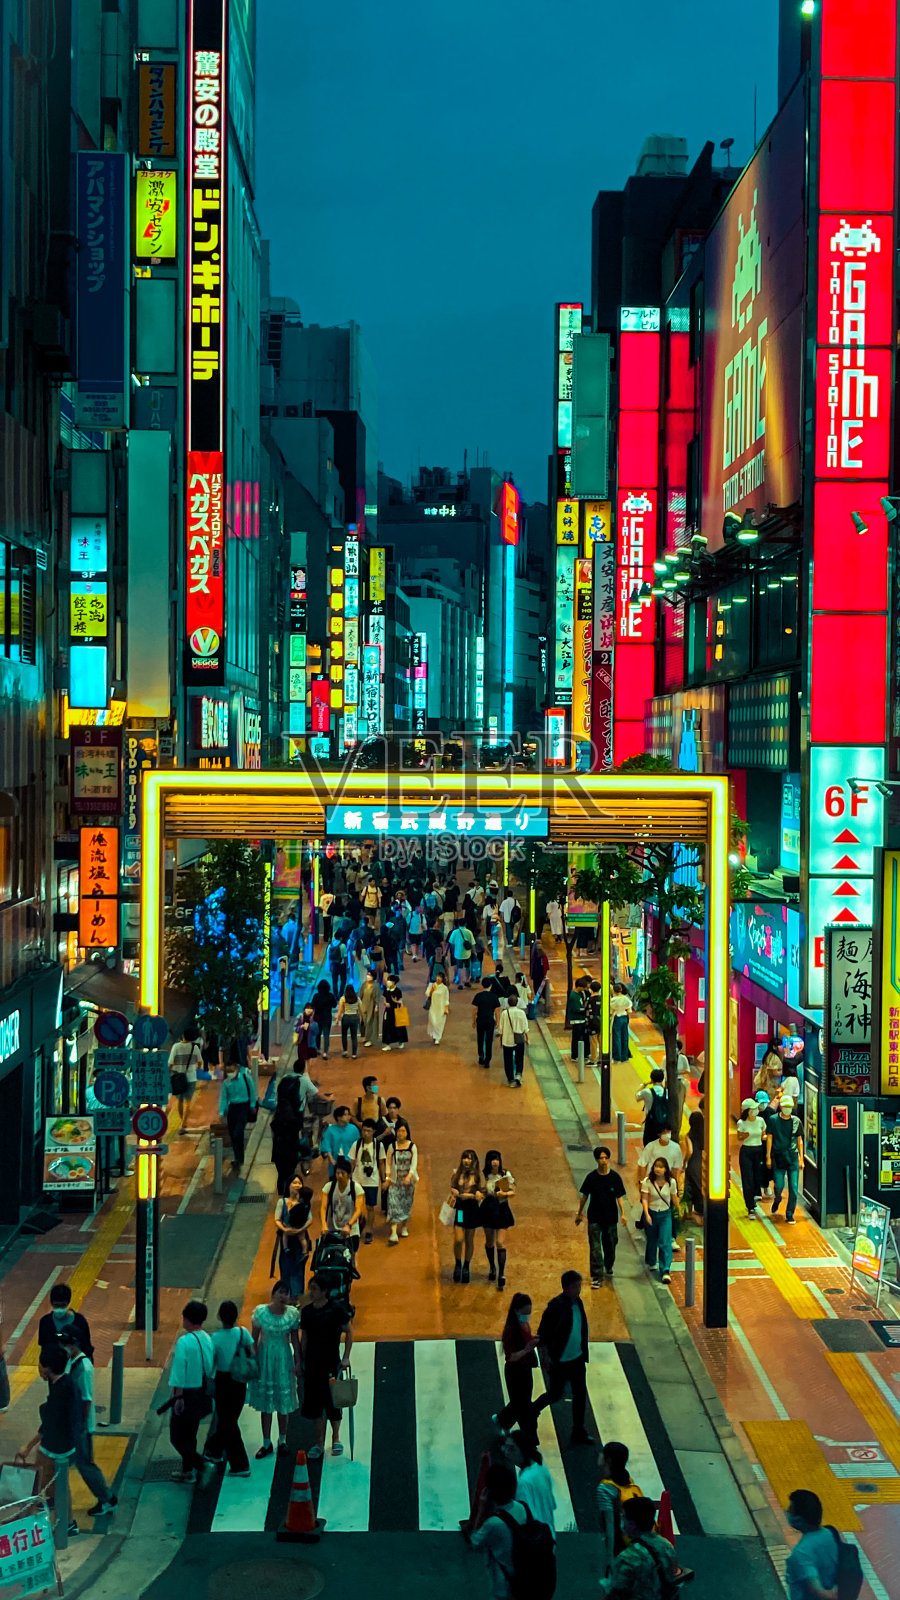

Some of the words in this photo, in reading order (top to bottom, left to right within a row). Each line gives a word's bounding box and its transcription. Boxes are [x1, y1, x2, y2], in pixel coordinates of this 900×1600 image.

[194, 51, 220, 180] 驚安の殿堂
[141, 170, 173, 178] カラオケ
[86, 160, 106, 293] アパマンショップ
[148, 180, 164, 255] 激安セブン
[622, 309, 656, 319] ワールド
[640, 321, 658, 330] ビル
[828, 261, 840, 344] TAITO
[724, 317, 767, 470] GAME
[840, 261, 879, 469] GAME
[826, 353, 840, 468] STATION
[189, 473, 210, 594] ベガスベガス
[620, 570, 628, 636] STATION
[416, 710, 424, 737] ZARA
[825, 785, 868, 817] 6F
[89, 831, 110, 944] 俺流塩らーめん
[833, 1003, 843, 1036] らーめん
[888, 1006, 900, 1088] 新宿駅東南口店
[835, 1064, 872, 1078] Highb
[840, 1049, 870, 1062] Pizza
[141, 1115, 160, 1131] 30
